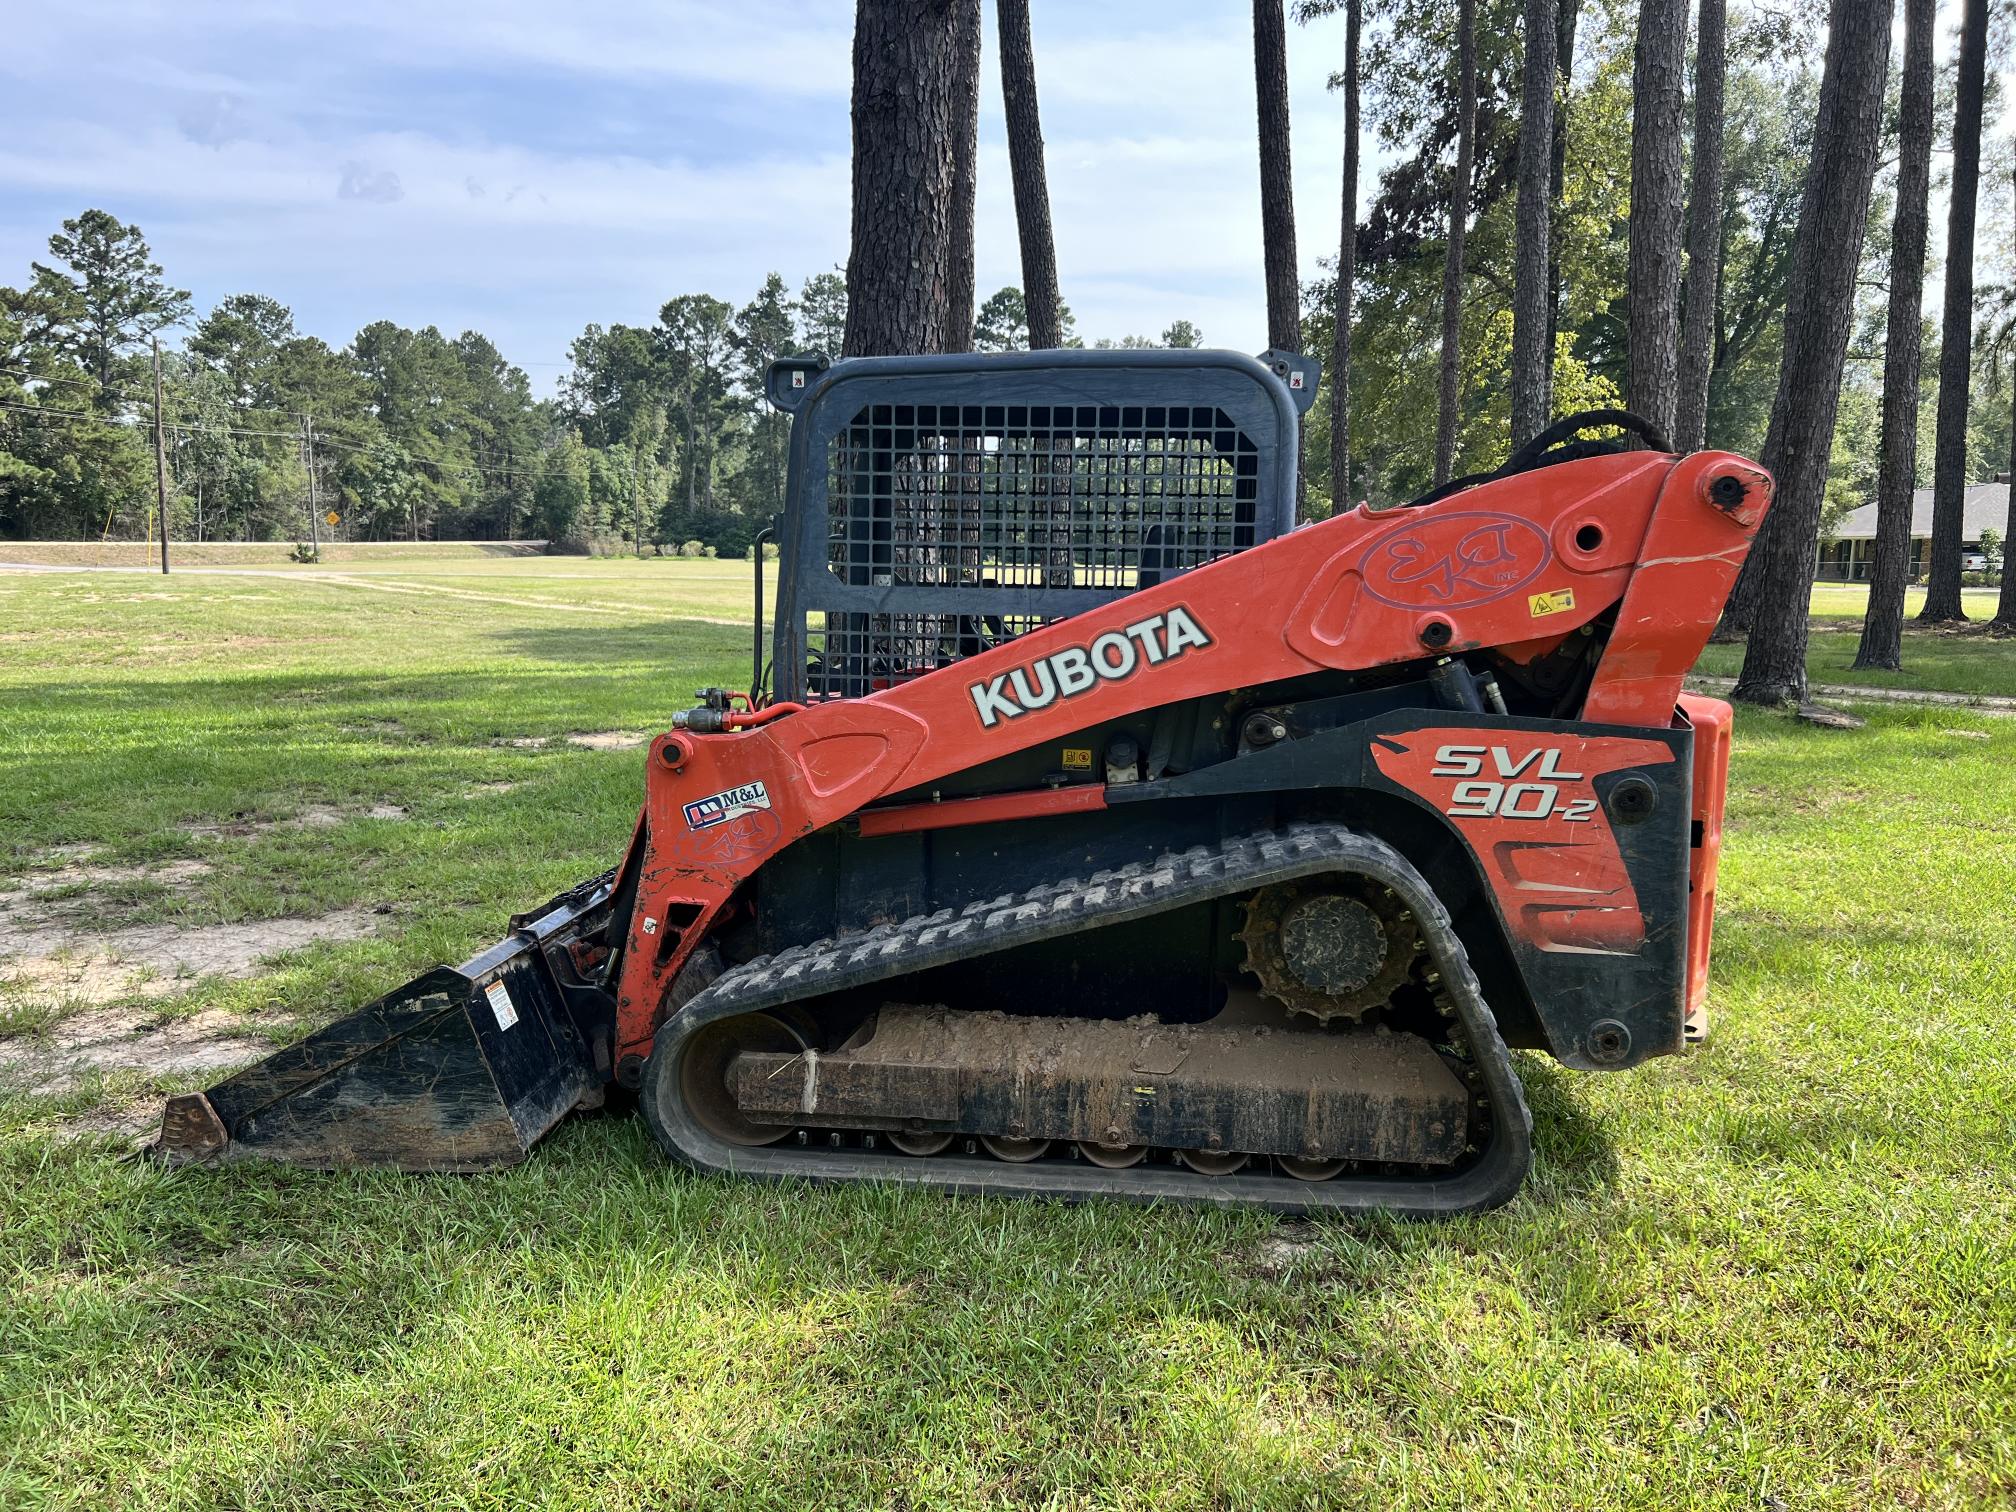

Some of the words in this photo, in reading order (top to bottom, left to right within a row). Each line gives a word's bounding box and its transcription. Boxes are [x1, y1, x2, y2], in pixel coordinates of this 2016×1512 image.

[969, 606, 1212, 728] KUBOTA
[1430, 745, 1584, 781] SVL
[720, 784, 765, 808] M&L
[1446, 781, 1599, 821] 90-2
